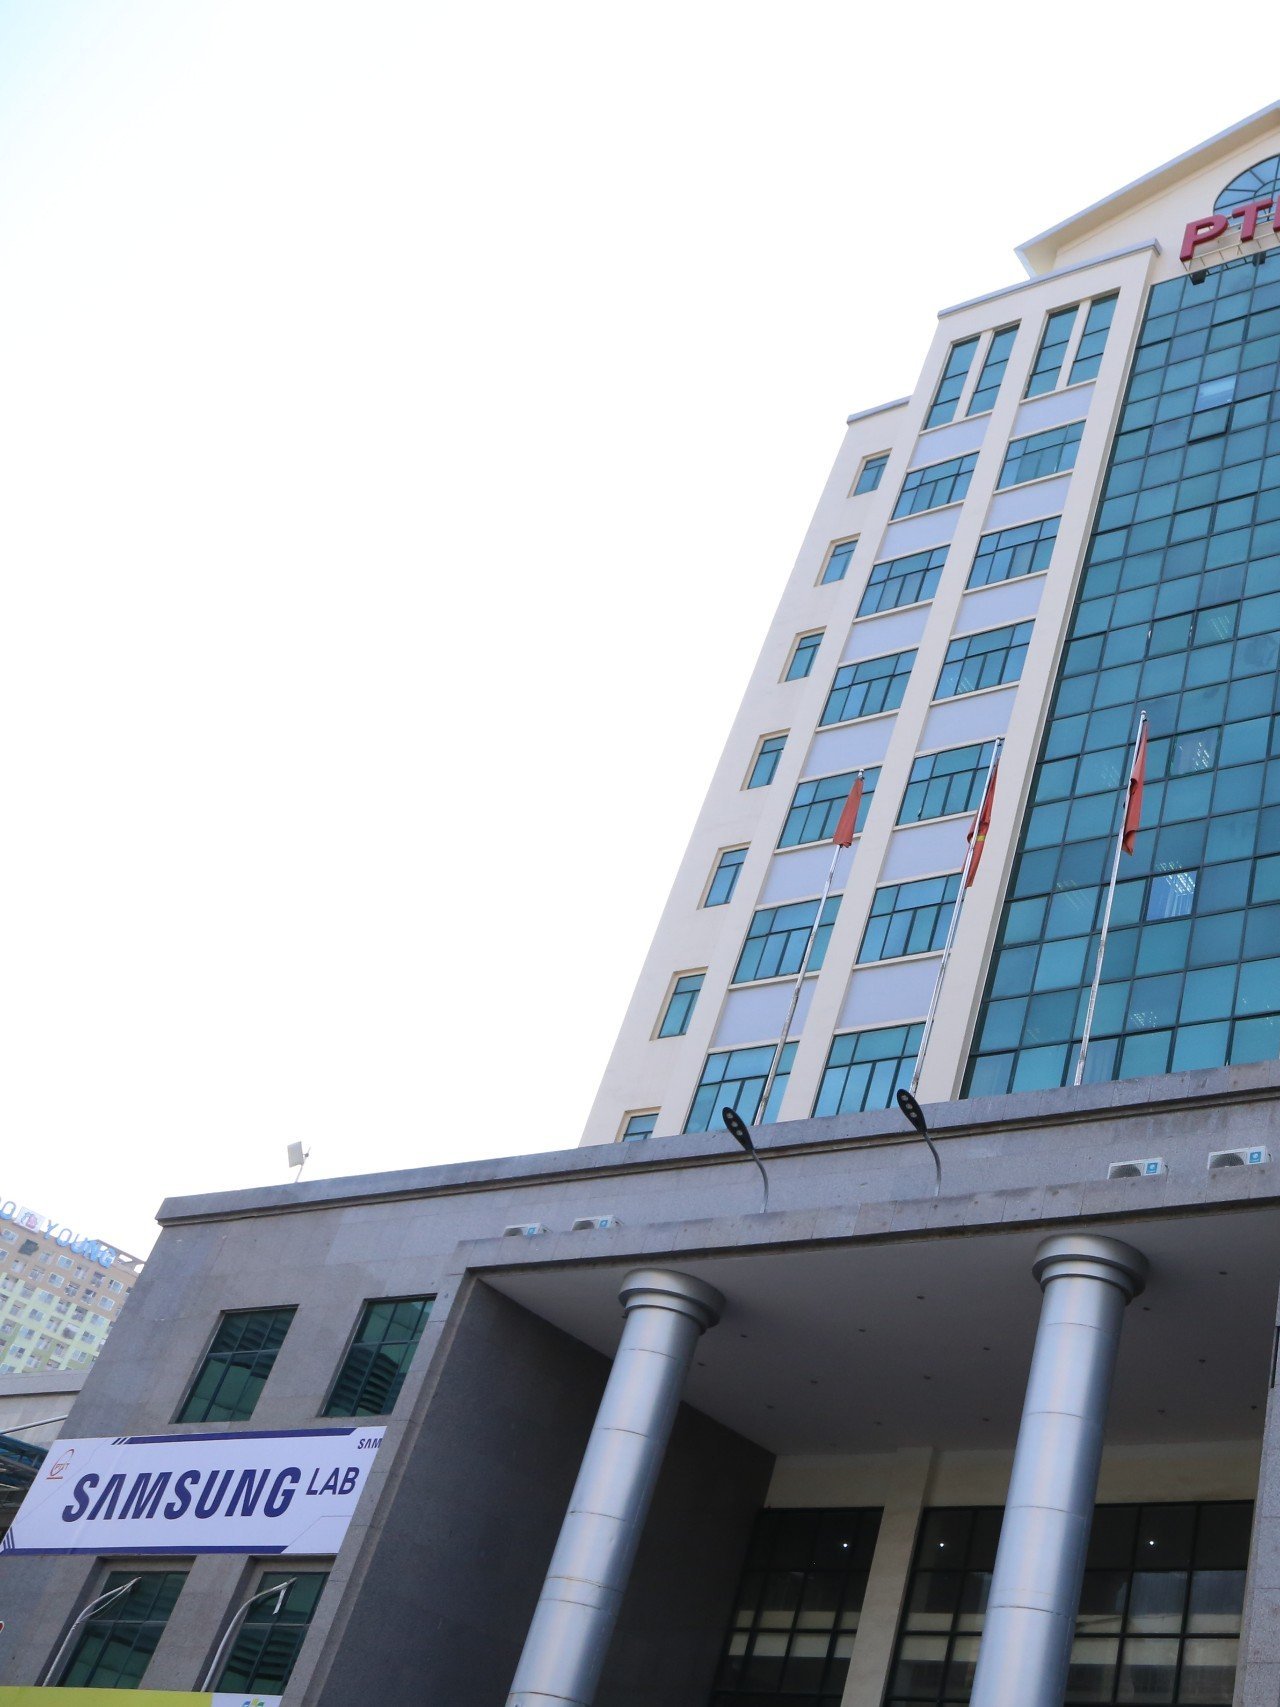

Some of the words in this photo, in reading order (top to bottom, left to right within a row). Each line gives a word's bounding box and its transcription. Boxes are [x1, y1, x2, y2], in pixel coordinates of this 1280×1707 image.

[44, 1219, 117, 1269] YOUNG
[357, 1438, 382, 1449] SAM
[62, 1468, 301, 1522] SAMSUNG
[306, 1466, 360, 1496] LAB
